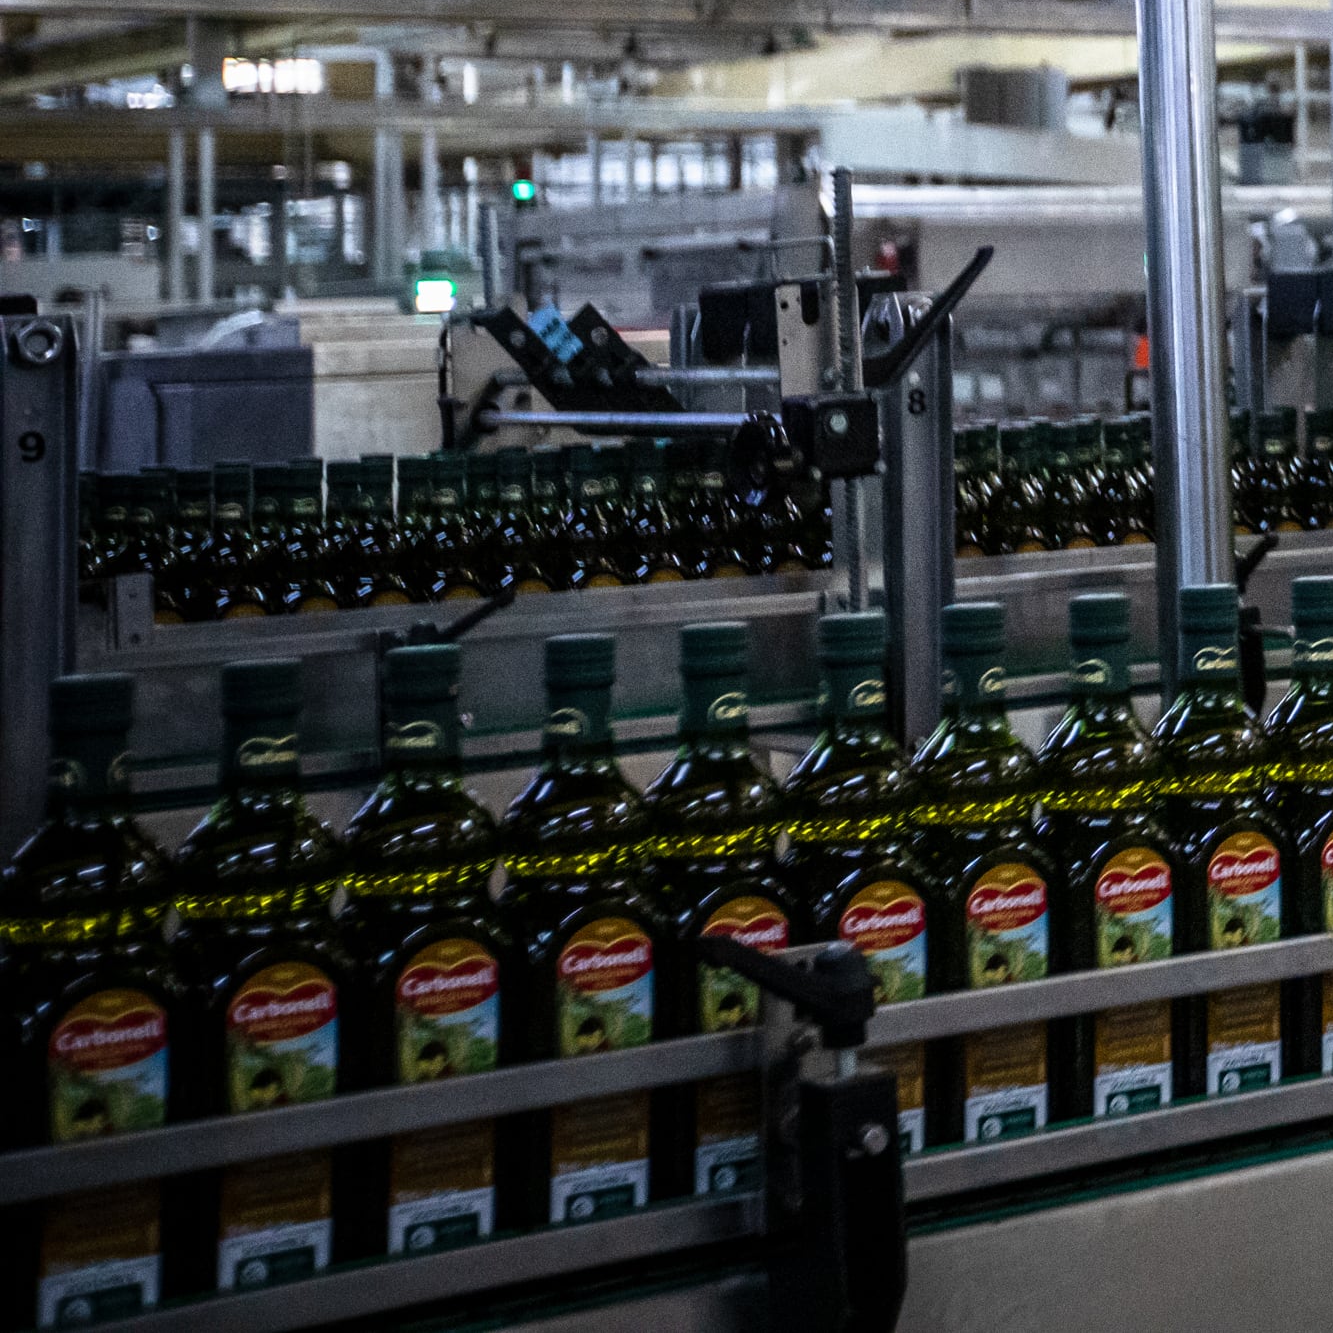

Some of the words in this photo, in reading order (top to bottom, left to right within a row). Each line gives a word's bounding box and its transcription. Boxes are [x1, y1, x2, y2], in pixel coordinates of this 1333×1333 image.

[908, 389, 926, 415] 8
[18, 430, 46, 464] 9
[1212, 856, 1277, 881] Carbonell
